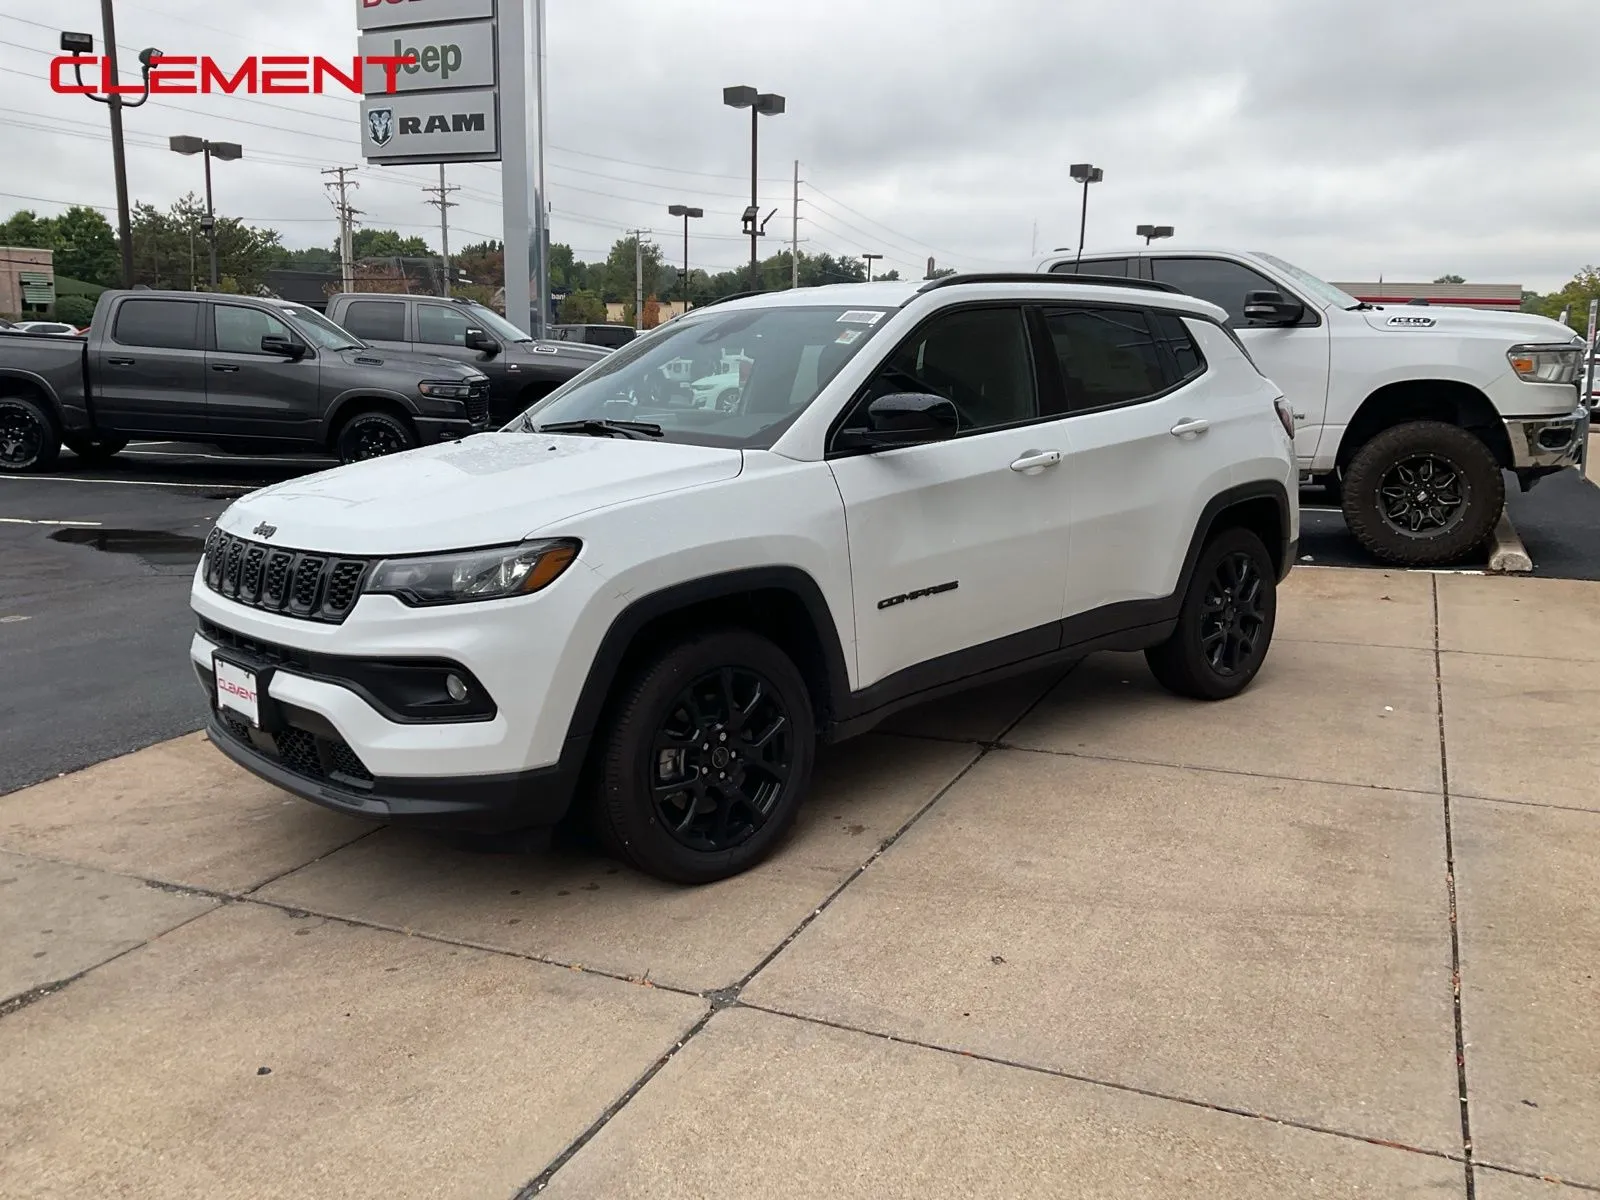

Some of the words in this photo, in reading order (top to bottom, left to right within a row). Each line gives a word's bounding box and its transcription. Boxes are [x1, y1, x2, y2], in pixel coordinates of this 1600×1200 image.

[383, 39, 462, 79] Jeep
[399, 113, 484, 134] RAM
[253, 521, 277, 539] Jeep
[877, 580, 959, 610] COMPASS
[218, 678, 257, 703] CLEMENT
